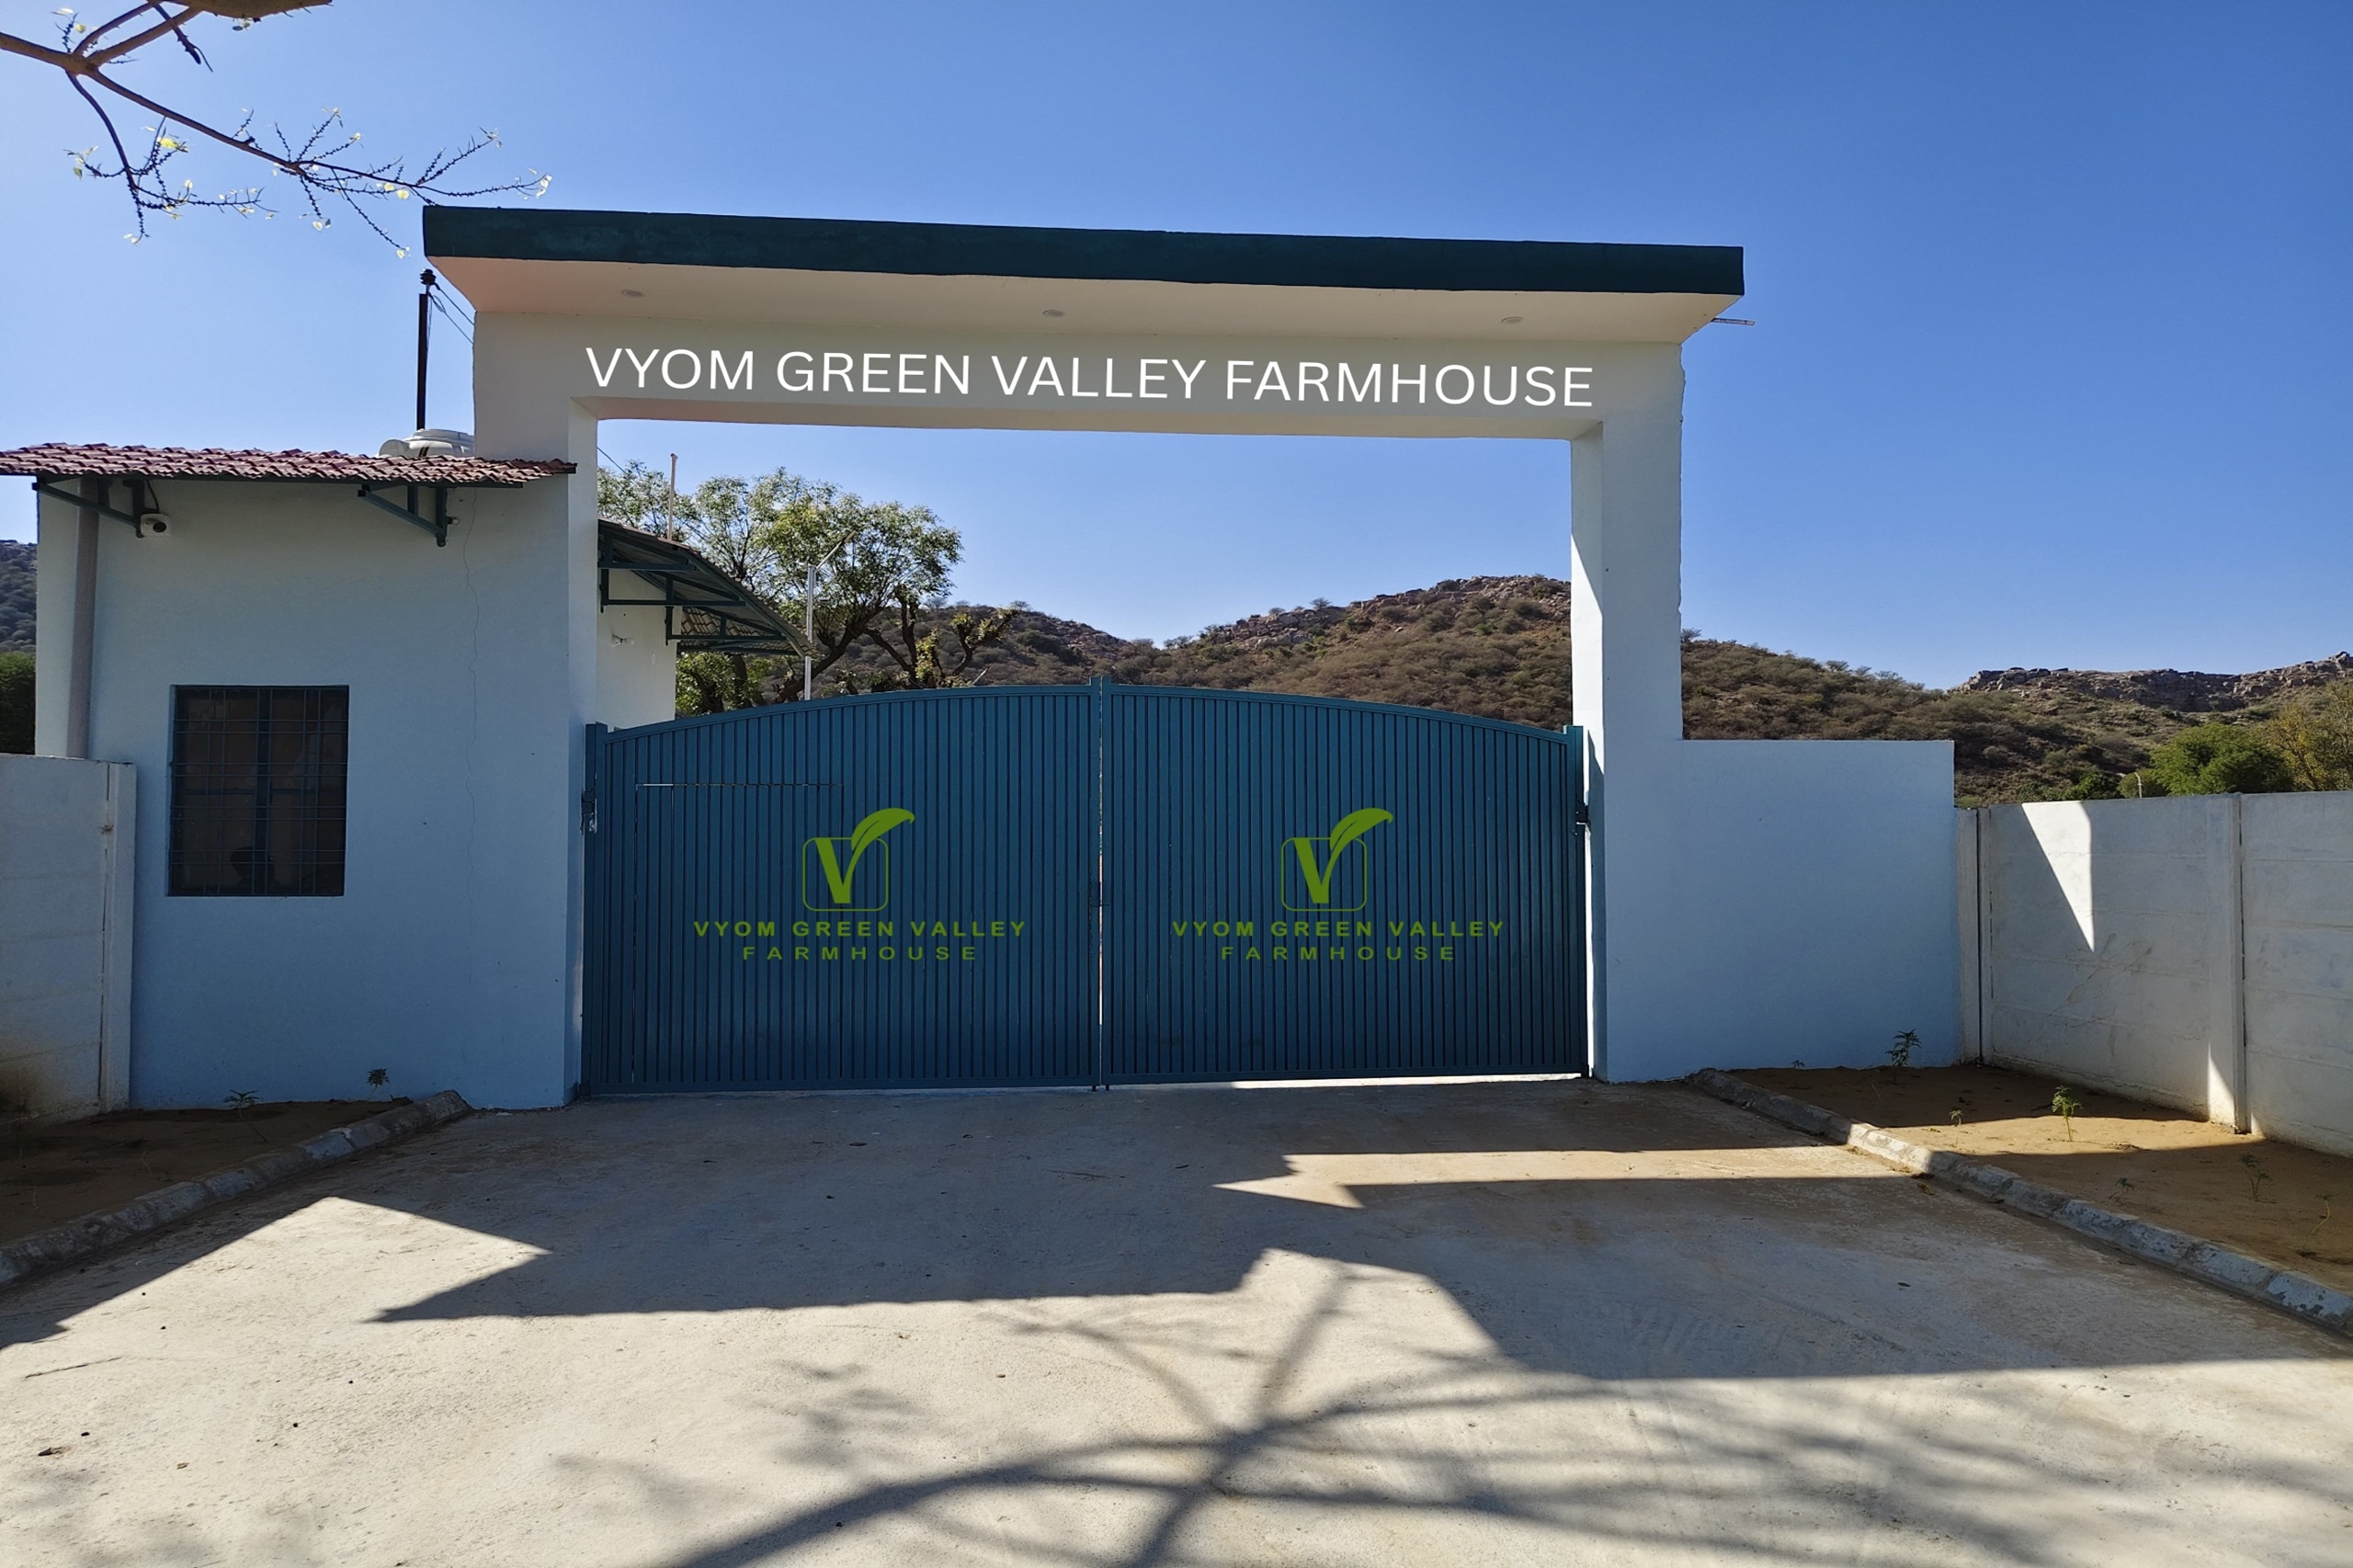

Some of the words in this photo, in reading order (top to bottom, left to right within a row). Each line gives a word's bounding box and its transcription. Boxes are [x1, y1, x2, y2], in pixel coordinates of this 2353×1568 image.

[585, 347, 754, 390] VYOM
[776, 351, 970, 393] GREEN
[991, 356, 1206, 399] VALLEY
[1225, 360, 1593, 407] FARMHOUSE
[694, 921, 776, 936] VYOM
[792, 921, 894, 936] GREEN
[911, 921, 1025, 936] VALLEY
[1172, 921, 1254, 936] VYOM
[1270, 921, 1372, 936] GREEN
[1389, 921, 1504, 936] VALLEY
[743, 947, 975, 960] FARMHOUSE
[1221, 947, 1453, 960] FARMHOUSE
